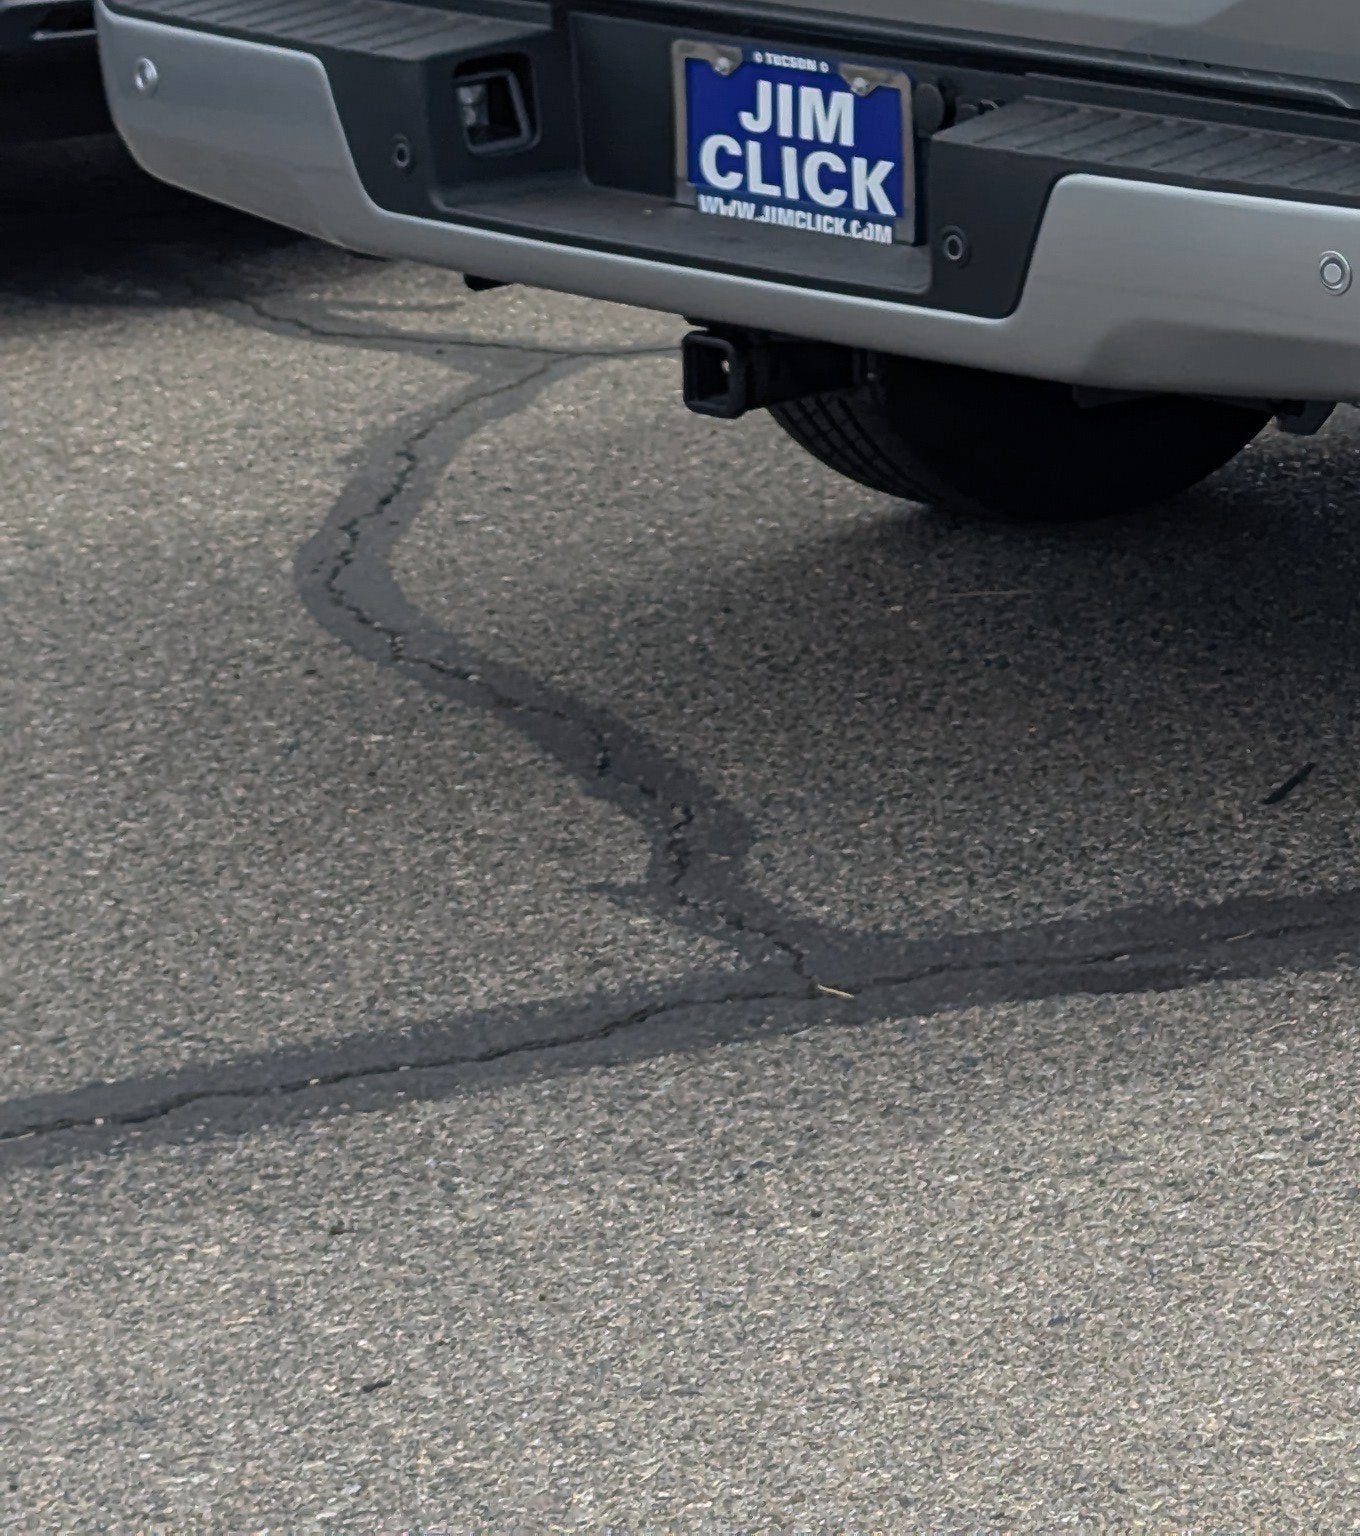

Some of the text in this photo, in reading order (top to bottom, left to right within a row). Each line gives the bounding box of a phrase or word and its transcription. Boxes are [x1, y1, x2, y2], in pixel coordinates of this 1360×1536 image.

[738, 79, 855, 147] JIM
[700, 133, 897, 217] CLICK
[698, 194, 893, 244] WWW.JIMCLICK.COM
